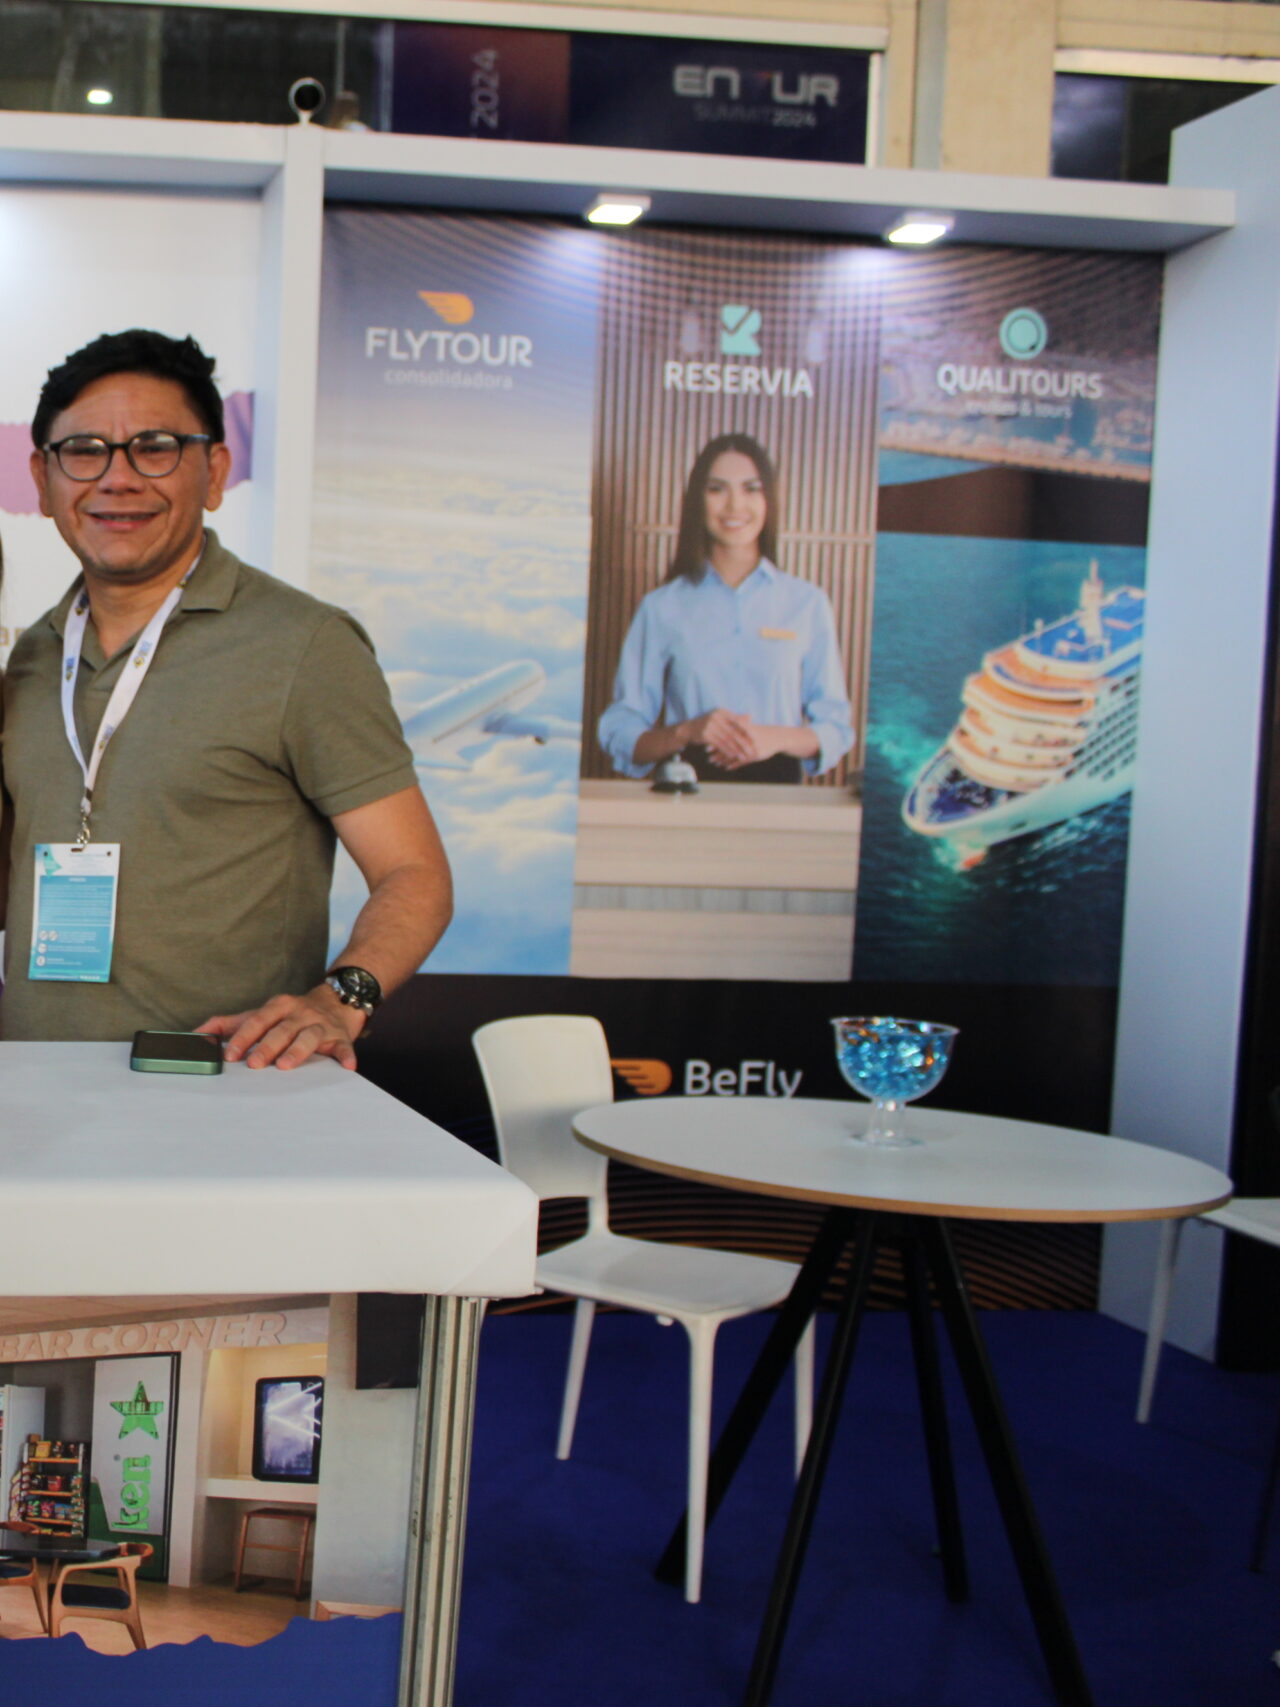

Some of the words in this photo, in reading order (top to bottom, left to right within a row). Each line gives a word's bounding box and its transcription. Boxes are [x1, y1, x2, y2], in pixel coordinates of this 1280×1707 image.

[471, 49, 500, 129] 2024
[365, 327, 533, 367] FLYTOUR
[384, 368, 513, 390] consolidadora
[664, 361, 814, 398] RESERVIA
[937, 363, 1103, 399] QUALITOURS
[684, 1059, 803, 1097] BeFly
[83, 1311, 288, 1354] CORNER
